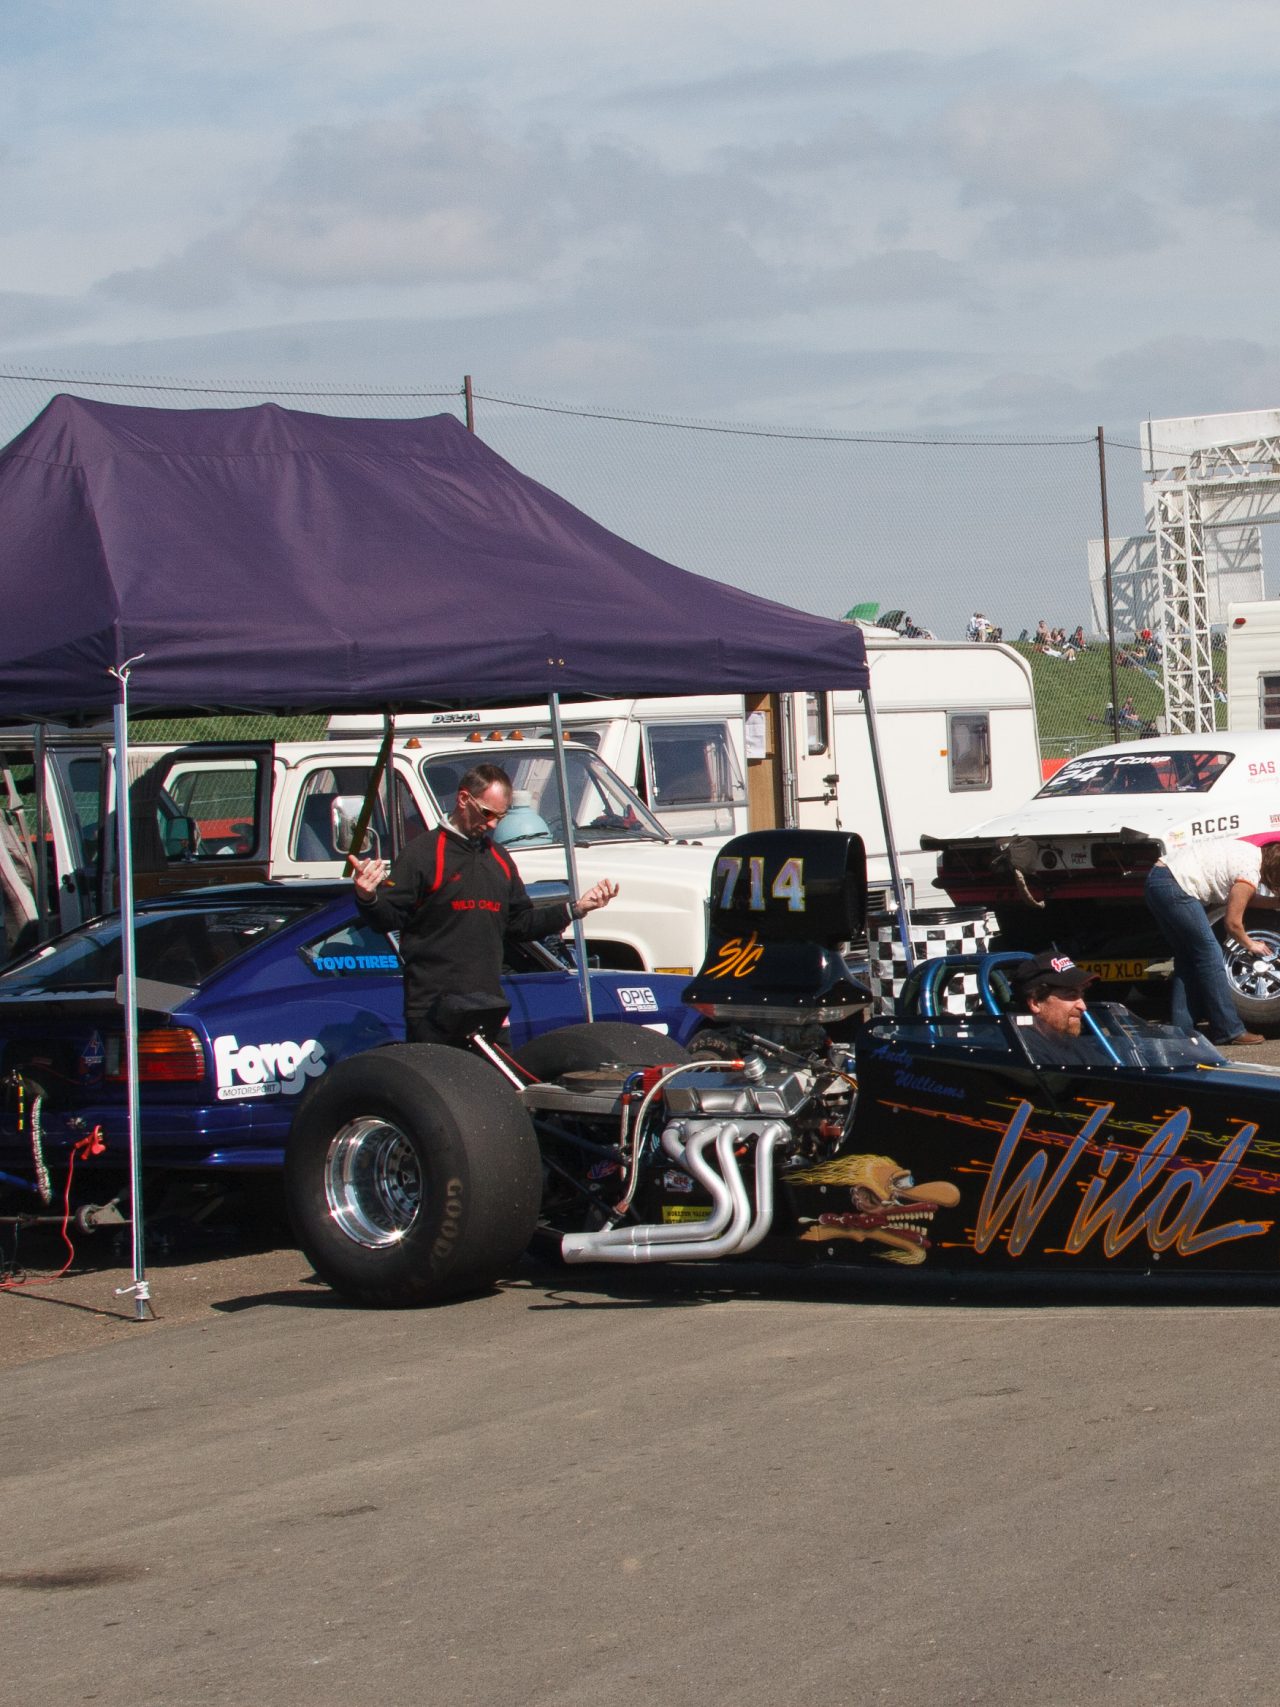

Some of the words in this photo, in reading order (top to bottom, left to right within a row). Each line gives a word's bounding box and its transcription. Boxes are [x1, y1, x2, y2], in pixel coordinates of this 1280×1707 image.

[432, 713, 480, 723] DELTA
[1248, 761, 1276, 776] SAS
[1048, 767, 1103, 786] 24
[1191, 814, 1240, 836] RCCS
[716, 856, 805, 912] 714
[451, 899, 476, 911] WILD
[313, 956, 357, 971] TOYO
[355, 955, 399, 969] TIRES
[620, 989, 655, 1004] OPIE
[222, 1083, 277, 1097] MOTORSPORT
[973, 1098, 1277, 1259] Wild
